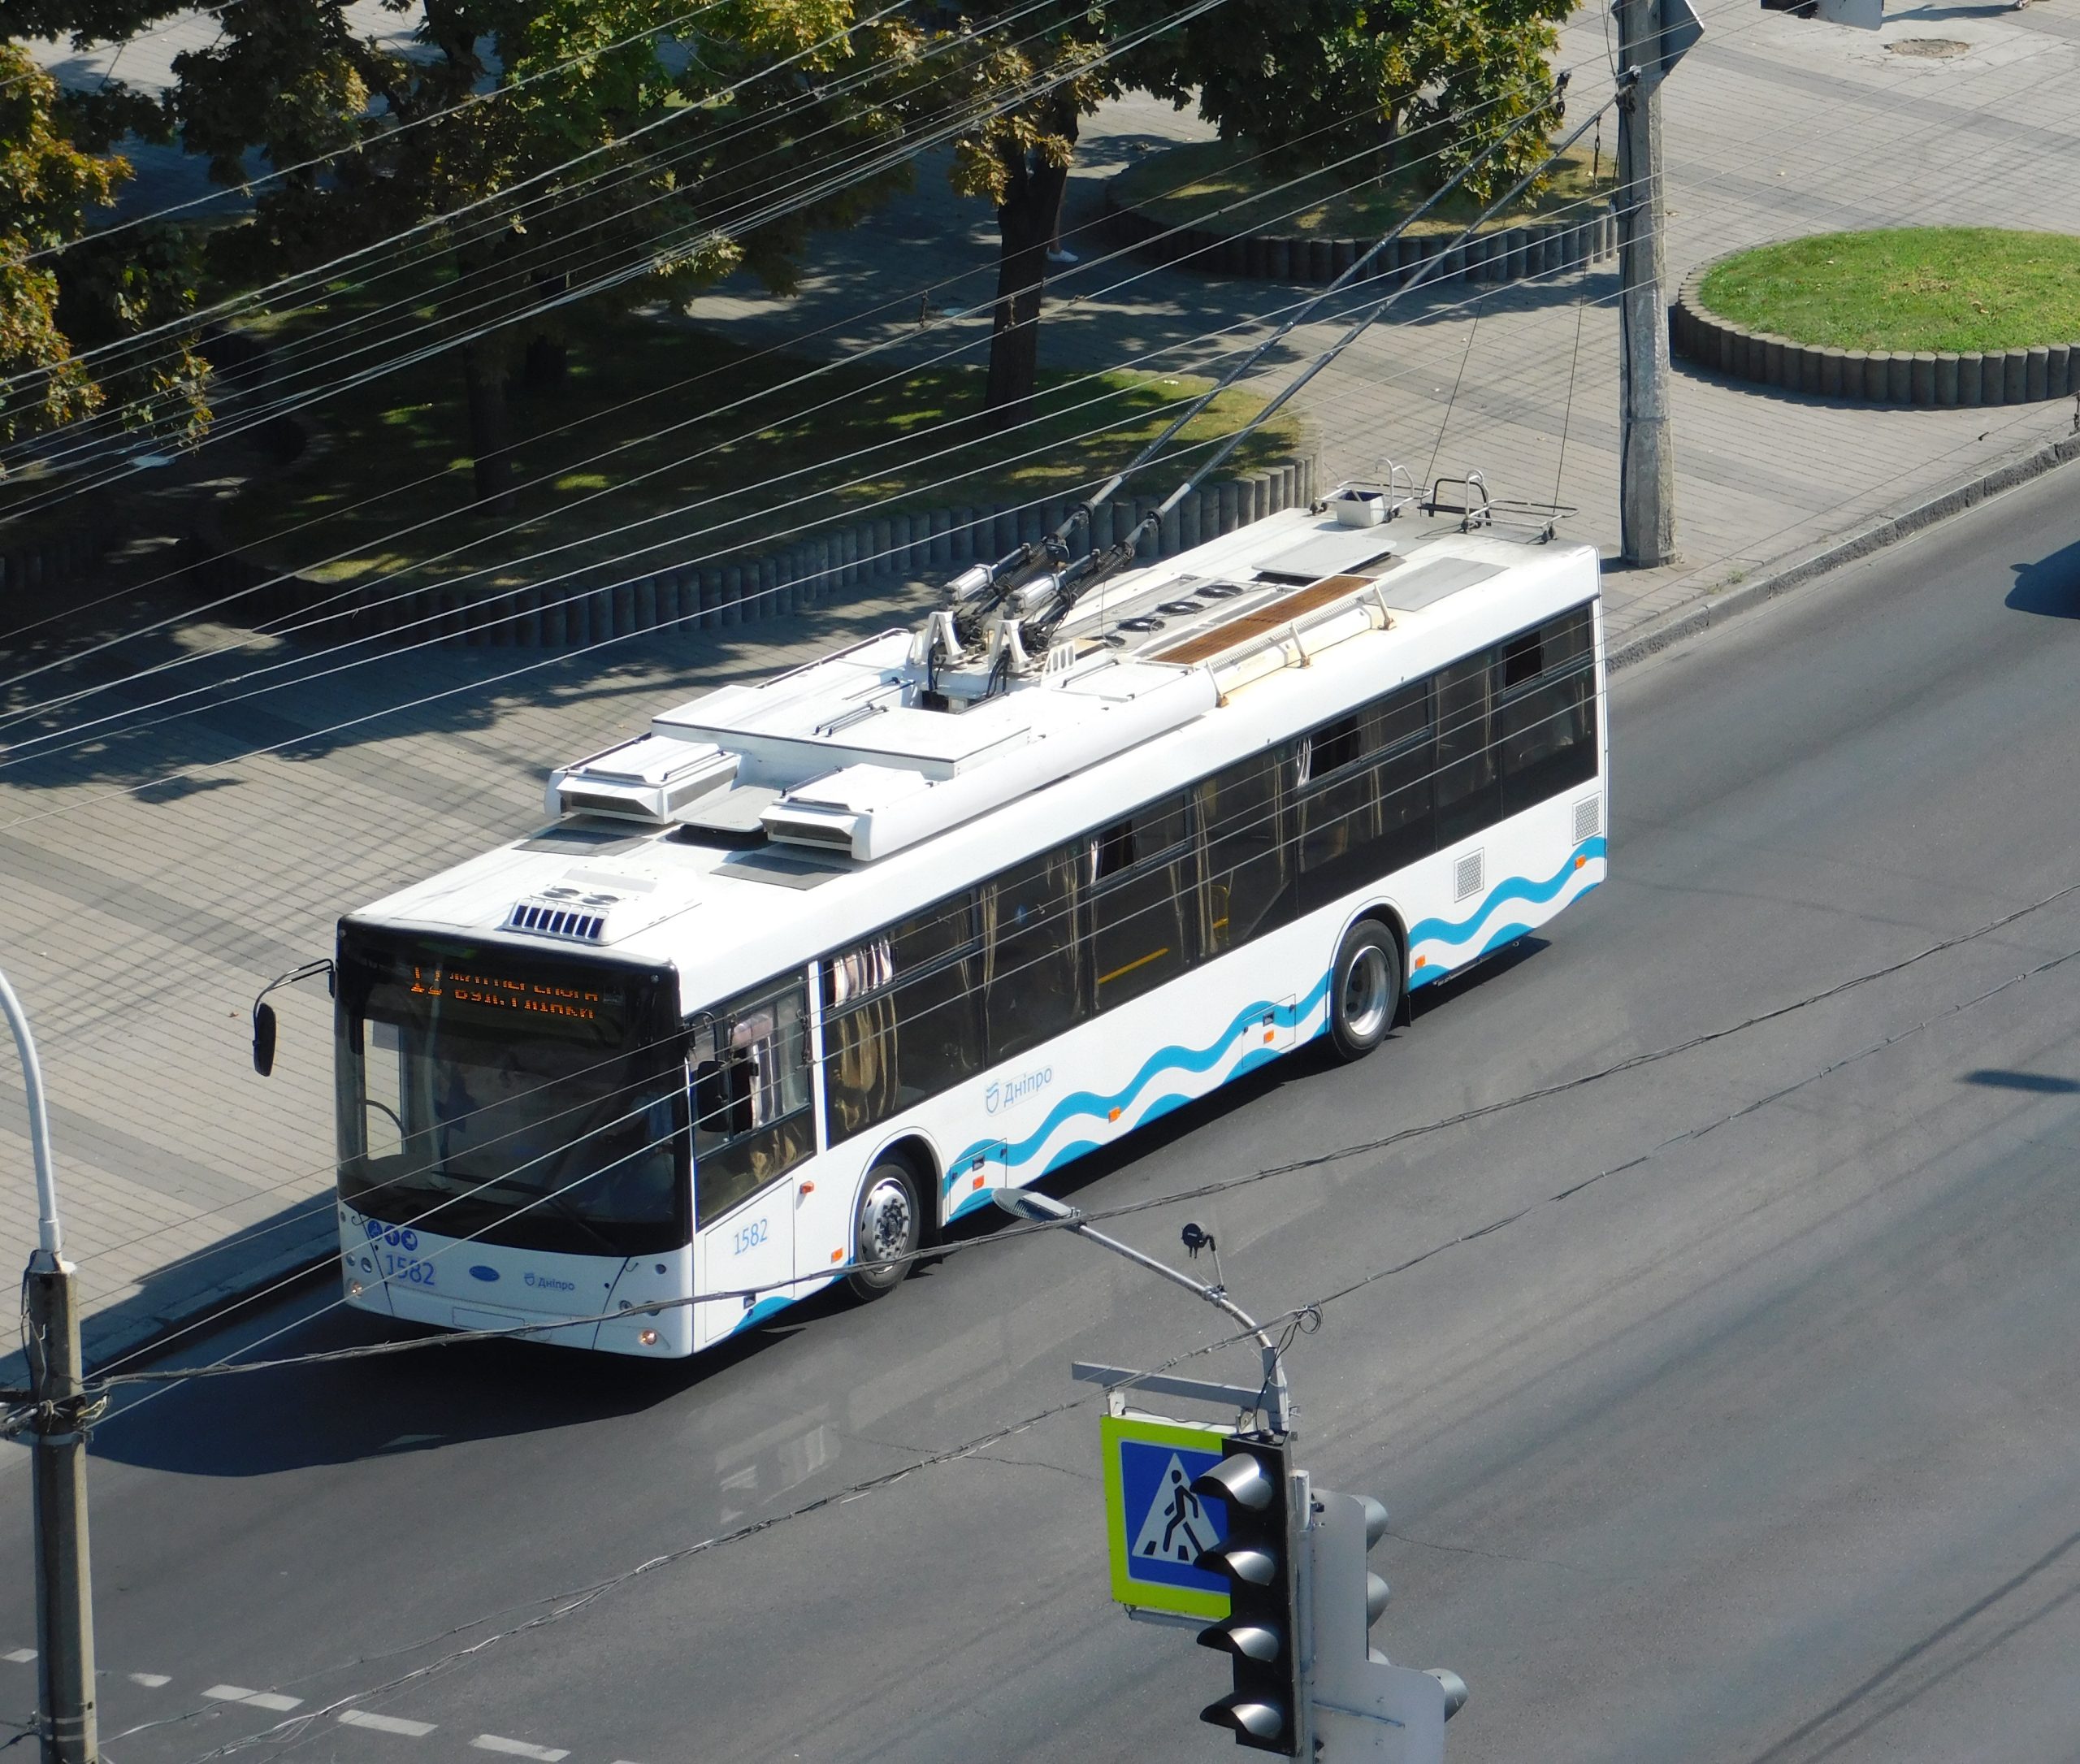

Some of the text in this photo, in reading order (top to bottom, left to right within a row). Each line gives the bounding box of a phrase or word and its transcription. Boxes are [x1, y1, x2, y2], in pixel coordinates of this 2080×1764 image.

[1003, 1068, 1052, 1107] Дніпро
[734, 1218, 768, 1256] 1582
[385, 1254, 435, 1285] 1582
[538, 1276, 575, 1291] Дніпро
